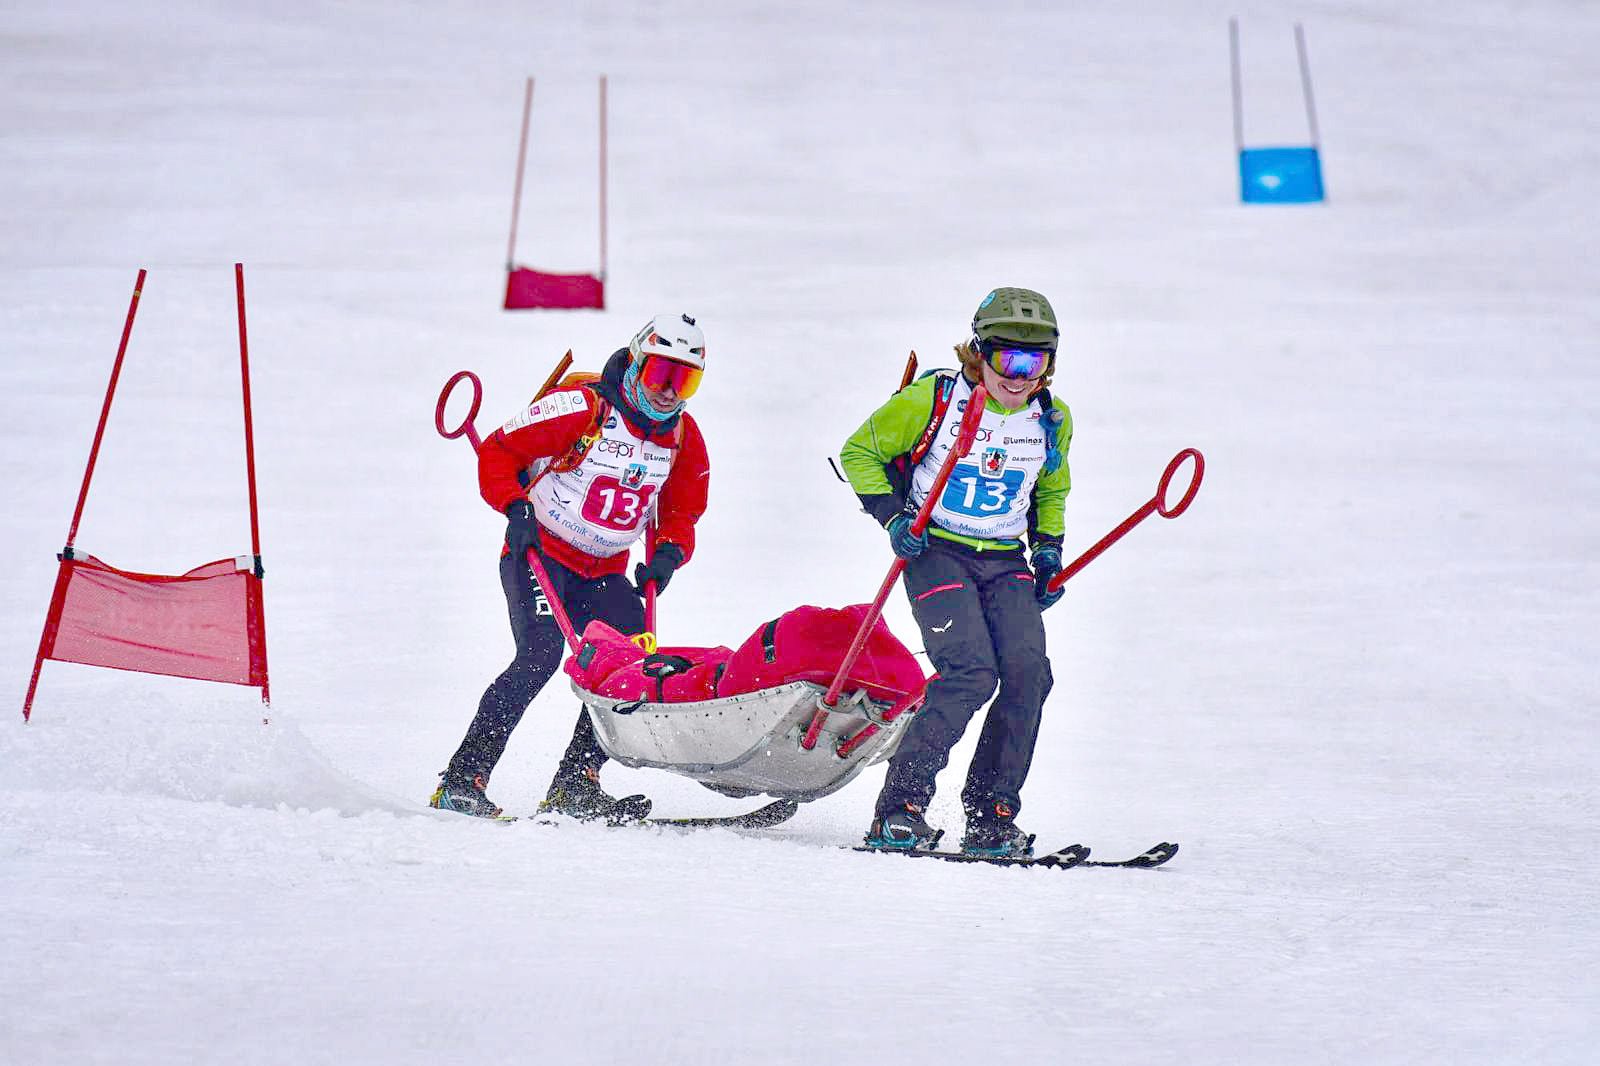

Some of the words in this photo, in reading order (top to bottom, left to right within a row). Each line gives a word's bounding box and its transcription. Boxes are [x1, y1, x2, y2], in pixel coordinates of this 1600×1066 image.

[599, 488, 640, 526] 13
[959, 476, 1009, 512] 13
[547, 508, 560, 524] 44.
